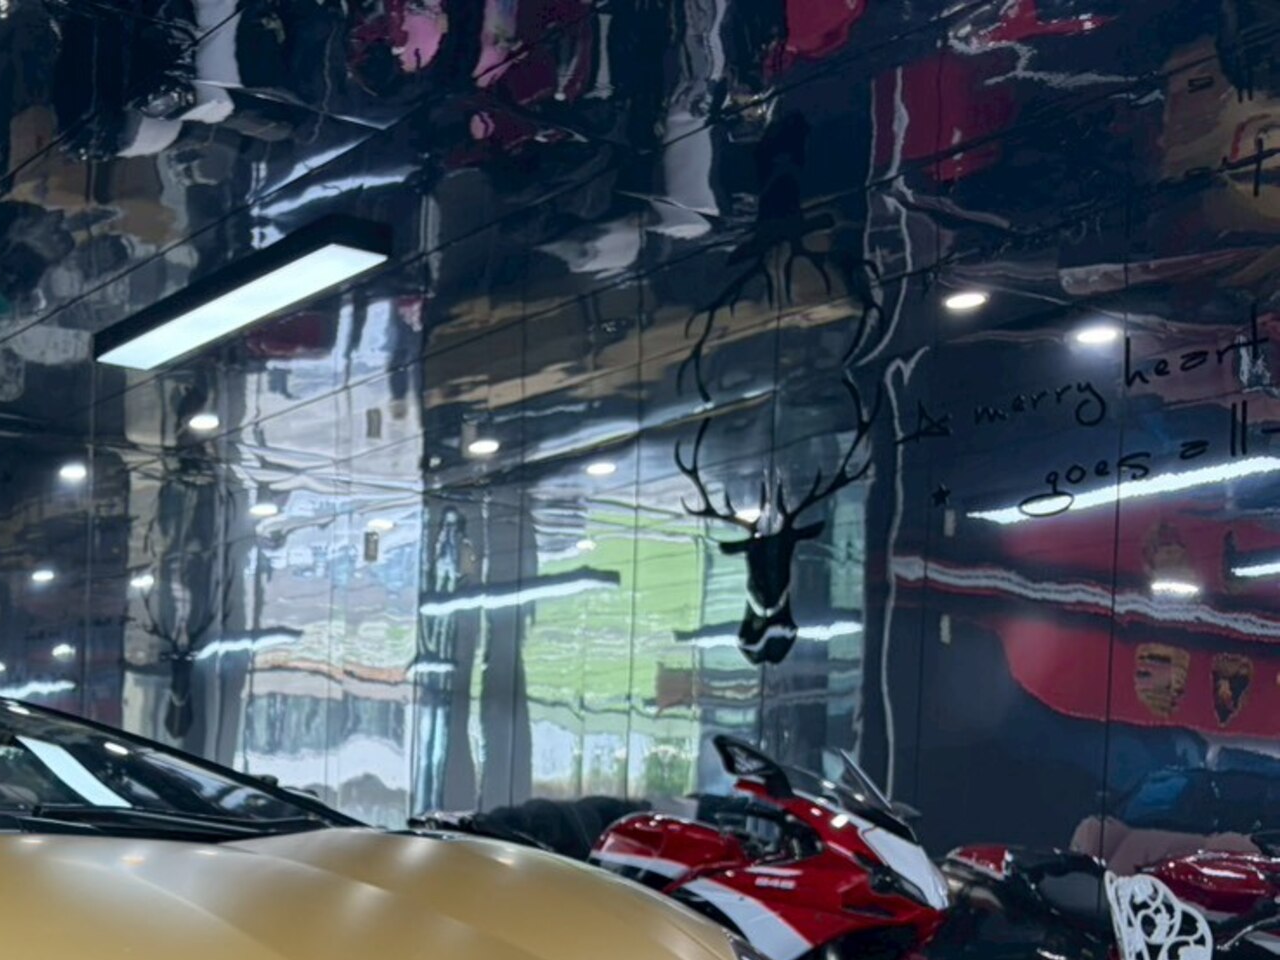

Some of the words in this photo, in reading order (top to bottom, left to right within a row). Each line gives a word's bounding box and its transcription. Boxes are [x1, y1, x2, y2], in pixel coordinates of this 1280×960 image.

[974, 381, 1107, 427] merry
[1124, 301, 1270, 387] heart
[1019, 452, 1151, 517] goes
